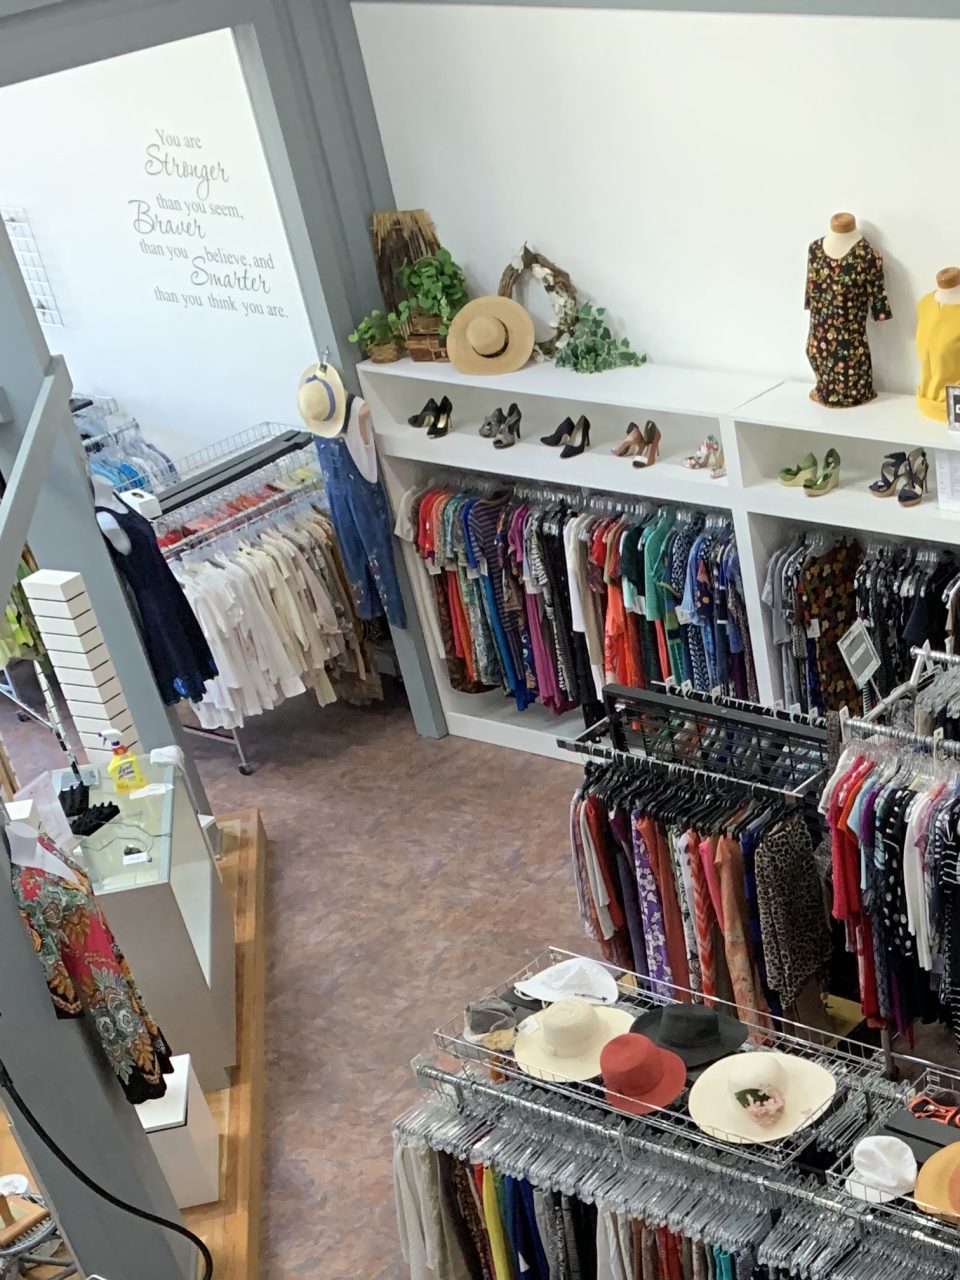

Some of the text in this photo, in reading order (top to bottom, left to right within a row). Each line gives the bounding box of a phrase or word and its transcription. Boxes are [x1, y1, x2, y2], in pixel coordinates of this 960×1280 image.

[155, 128, 202, 149] You are
[144, 143, 230, 201] Stronger
[128, 199, 206, 239] Braver
[156, 193, 244, 220] than you seem,
[139, 239, 164, 256] than
[166, 245, 188, 261] you
[253, 253, 275, 270] and
[190, 255, 271, 294] Smarter
[154, 286, 289, 319] than you think you are.
